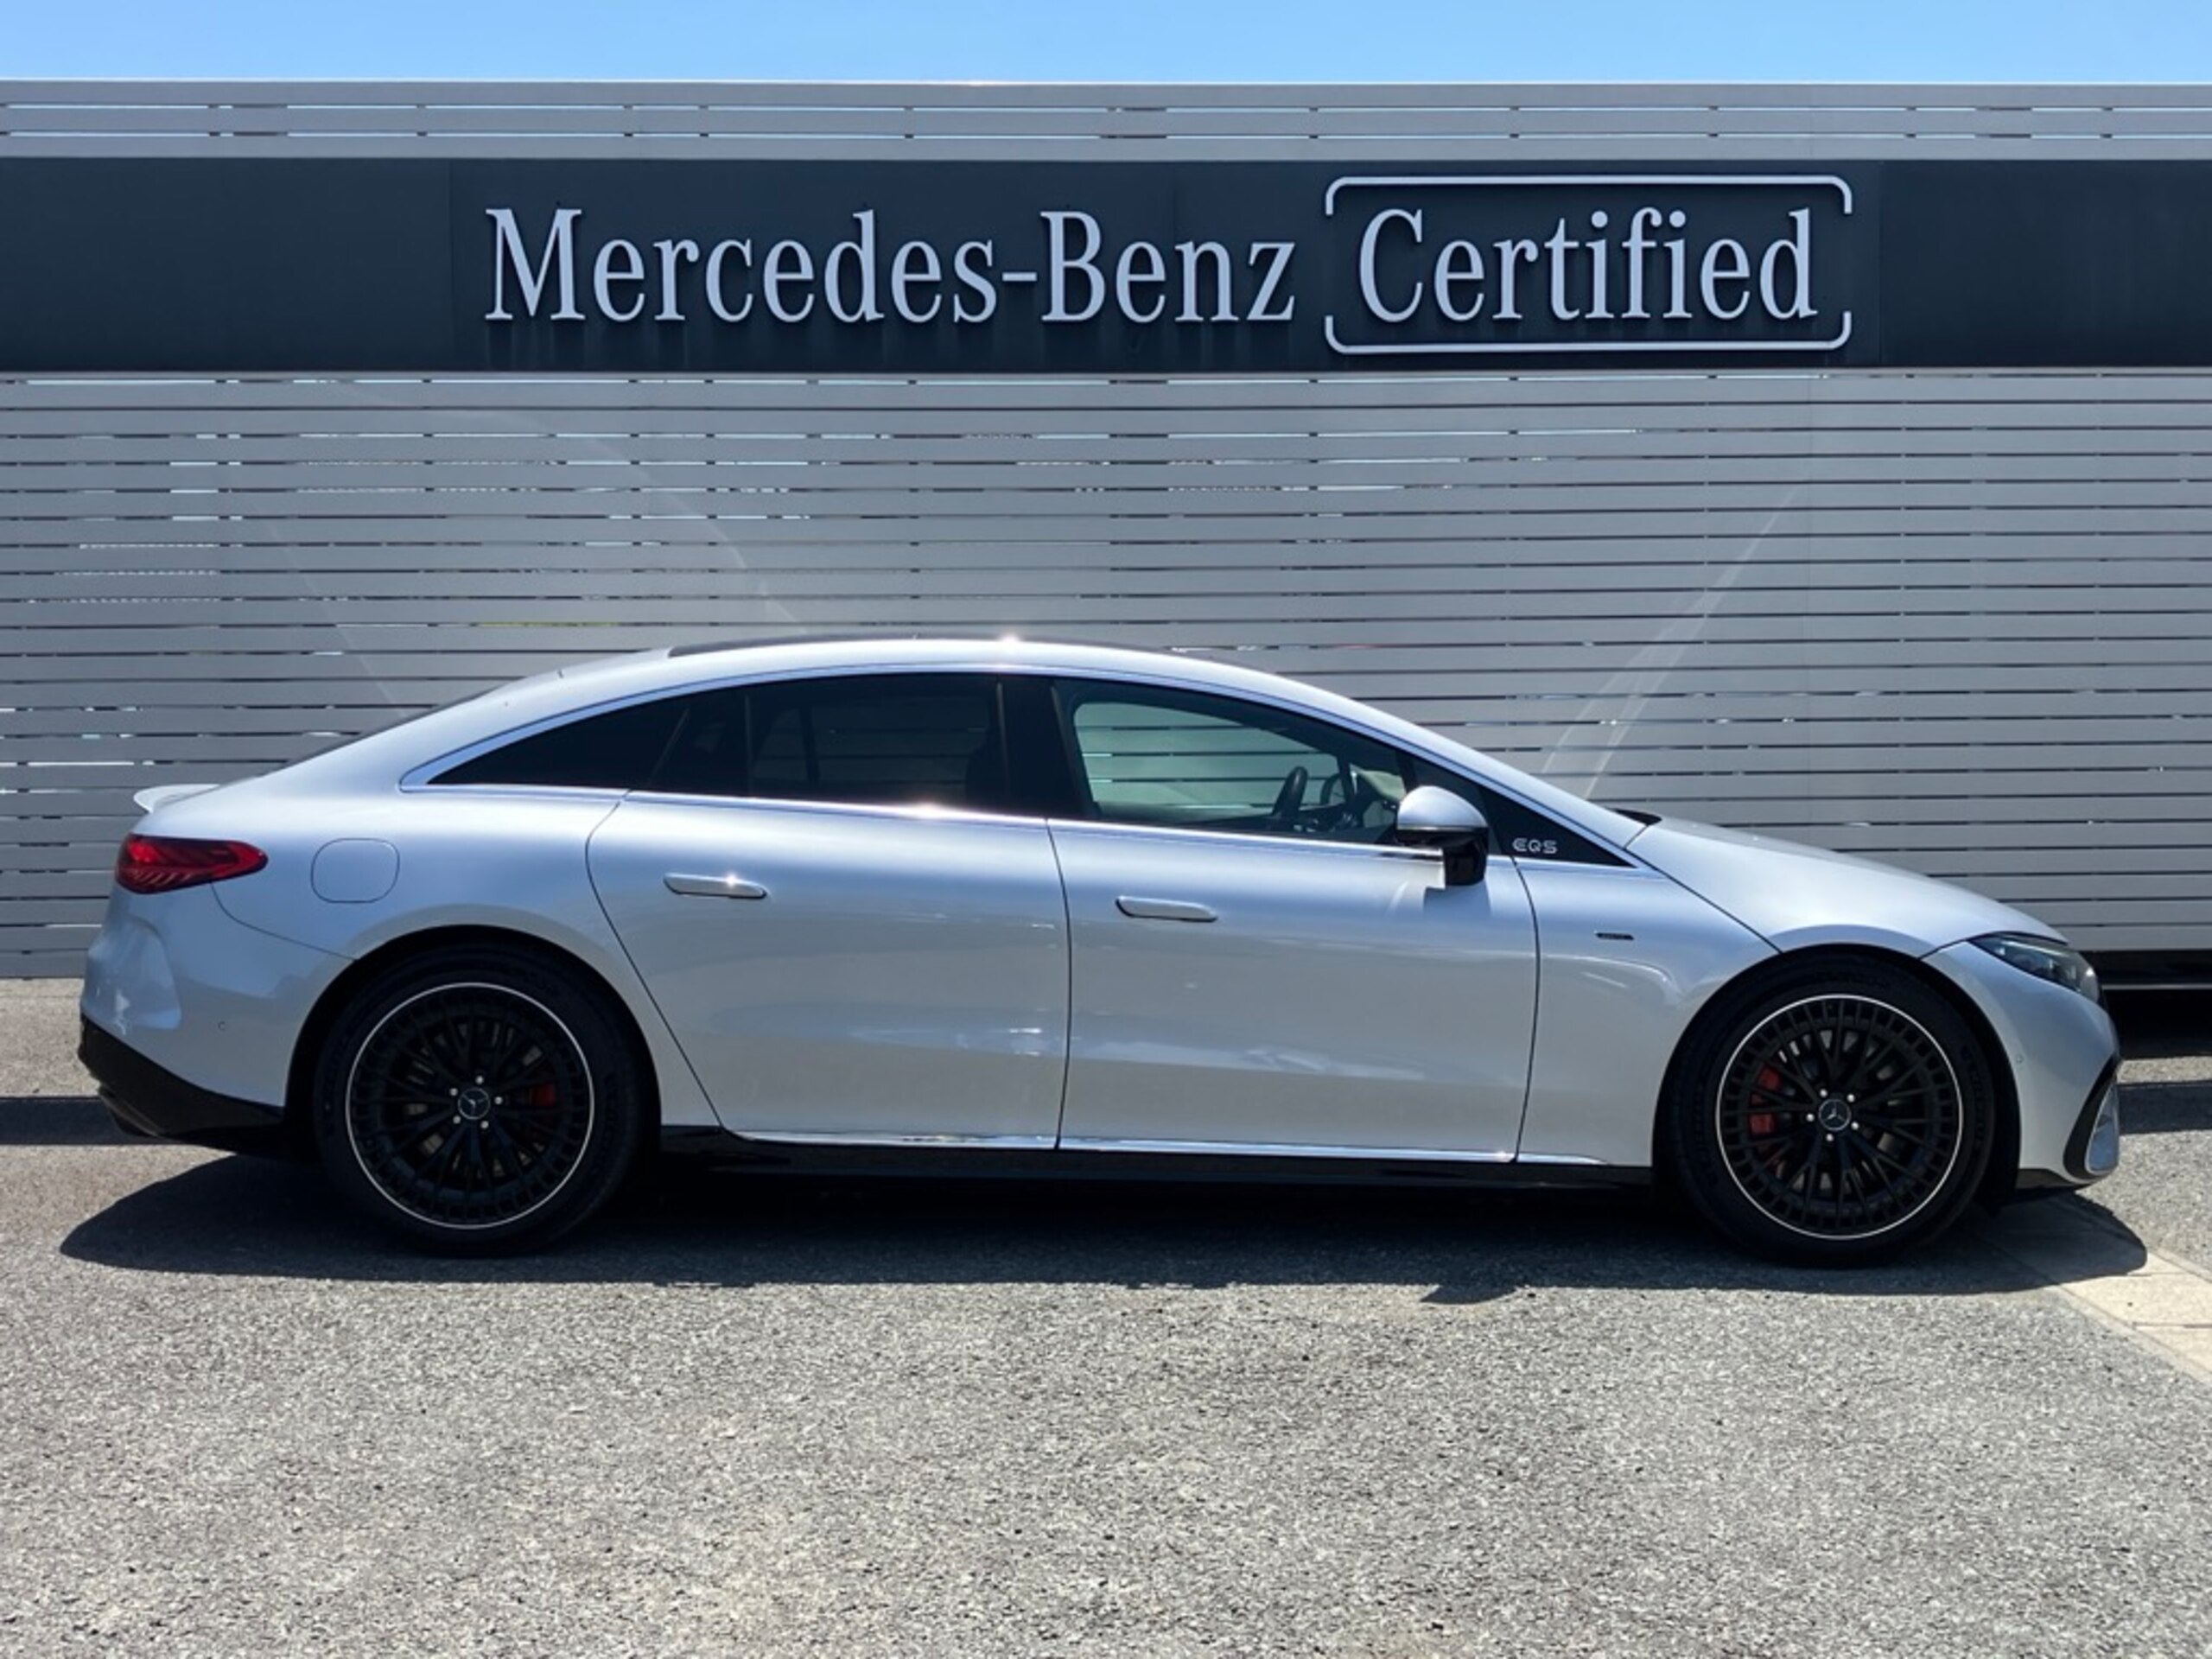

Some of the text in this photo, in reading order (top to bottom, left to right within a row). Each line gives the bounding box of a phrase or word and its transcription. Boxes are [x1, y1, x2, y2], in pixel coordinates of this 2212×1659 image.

[484, 207, 1819, 323] Mercedes-Benz Certified
[1512, 837, 1558, 854] EQS
